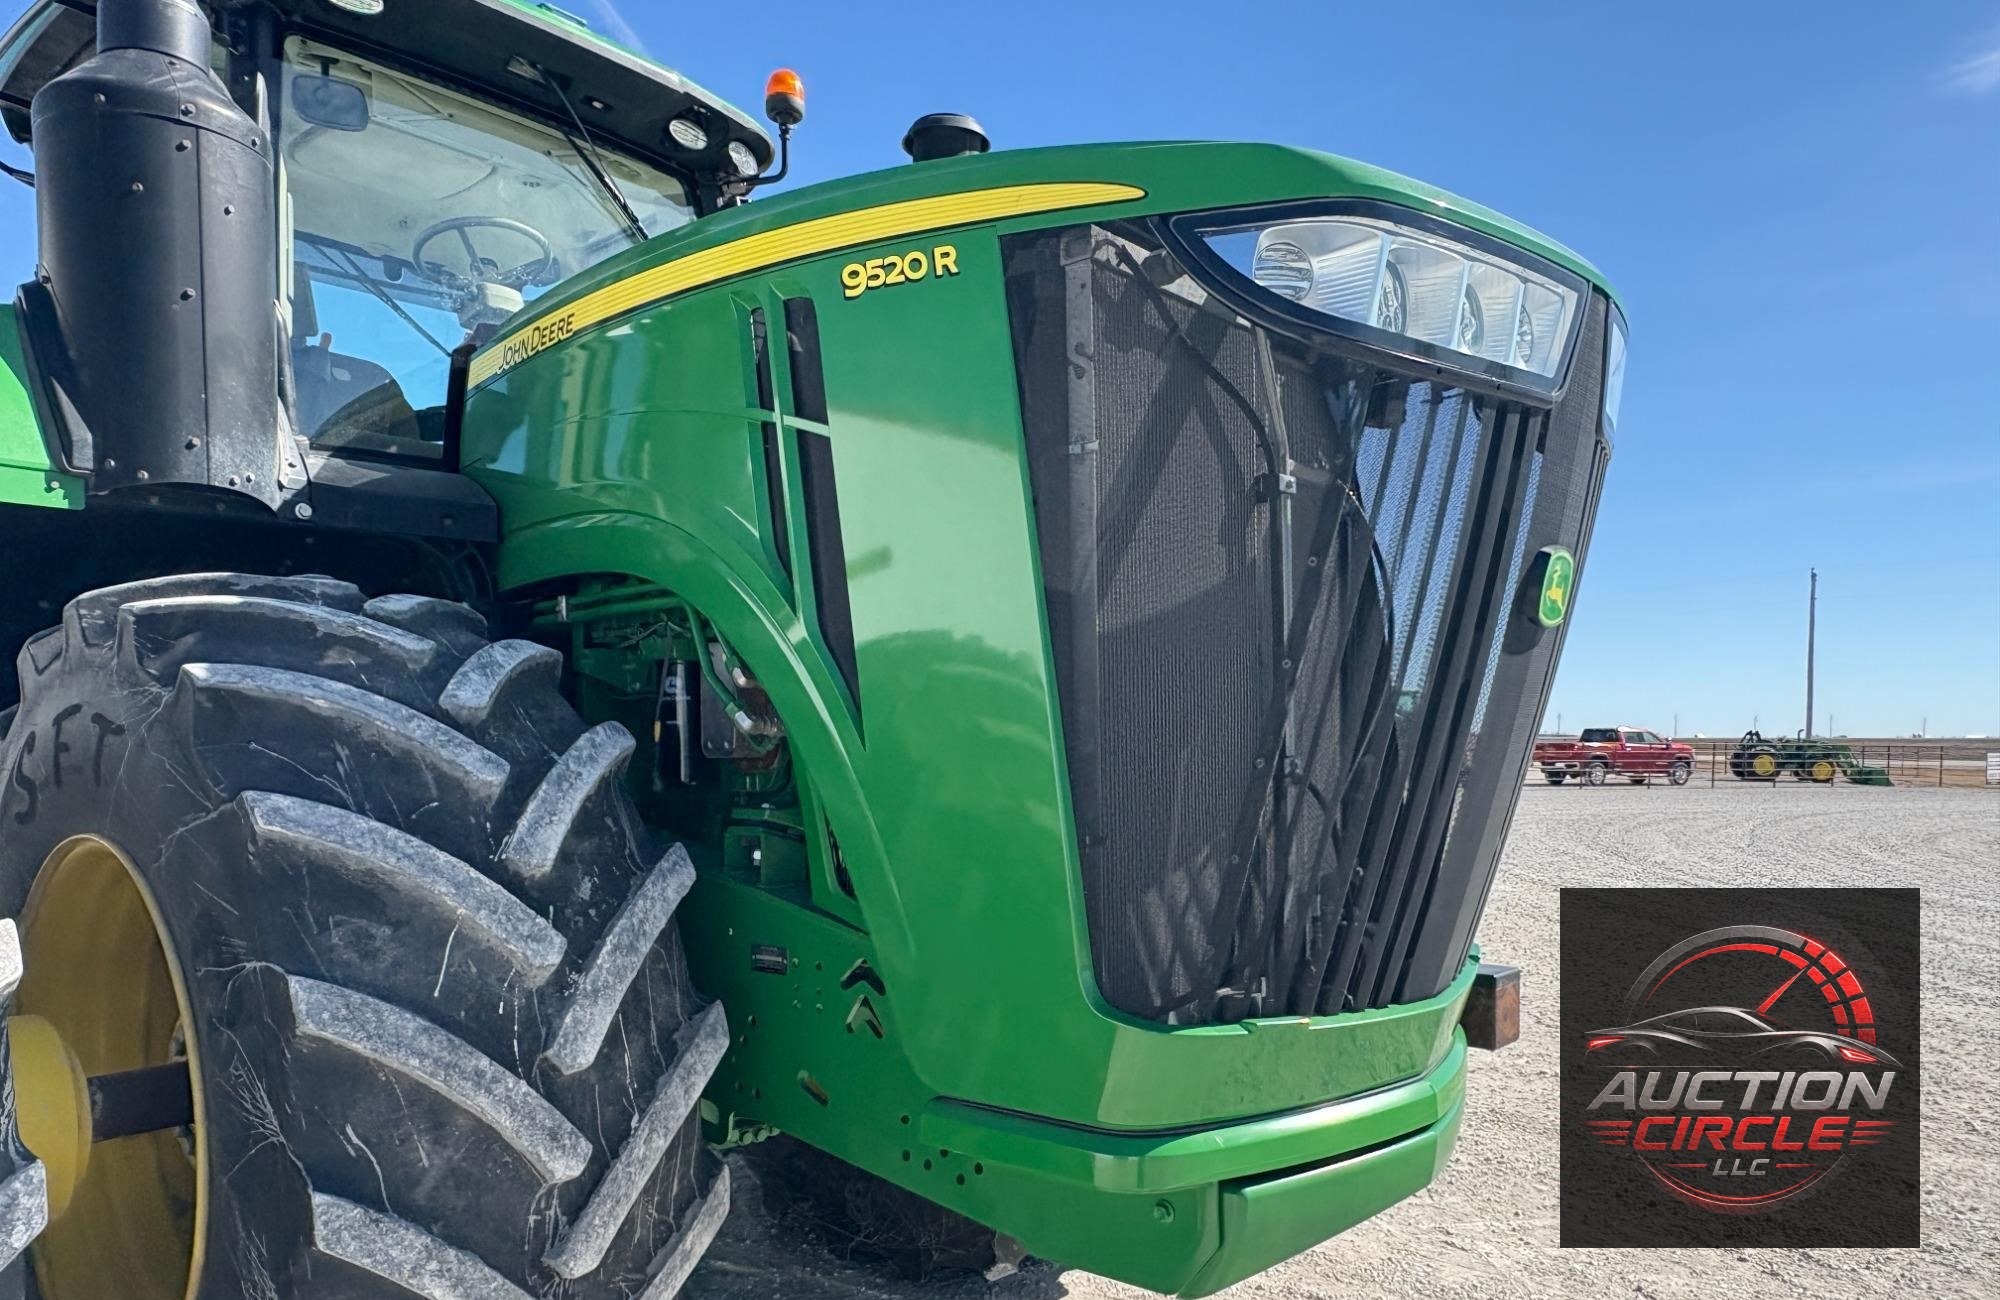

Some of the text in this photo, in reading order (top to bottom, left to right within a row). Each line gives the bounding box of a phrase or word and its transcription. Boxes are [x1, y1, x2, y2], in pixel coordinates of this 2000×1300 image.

[841, 245, 960, 299] 9520 R
[498, 312, 576, 372] JOHN DEERE
